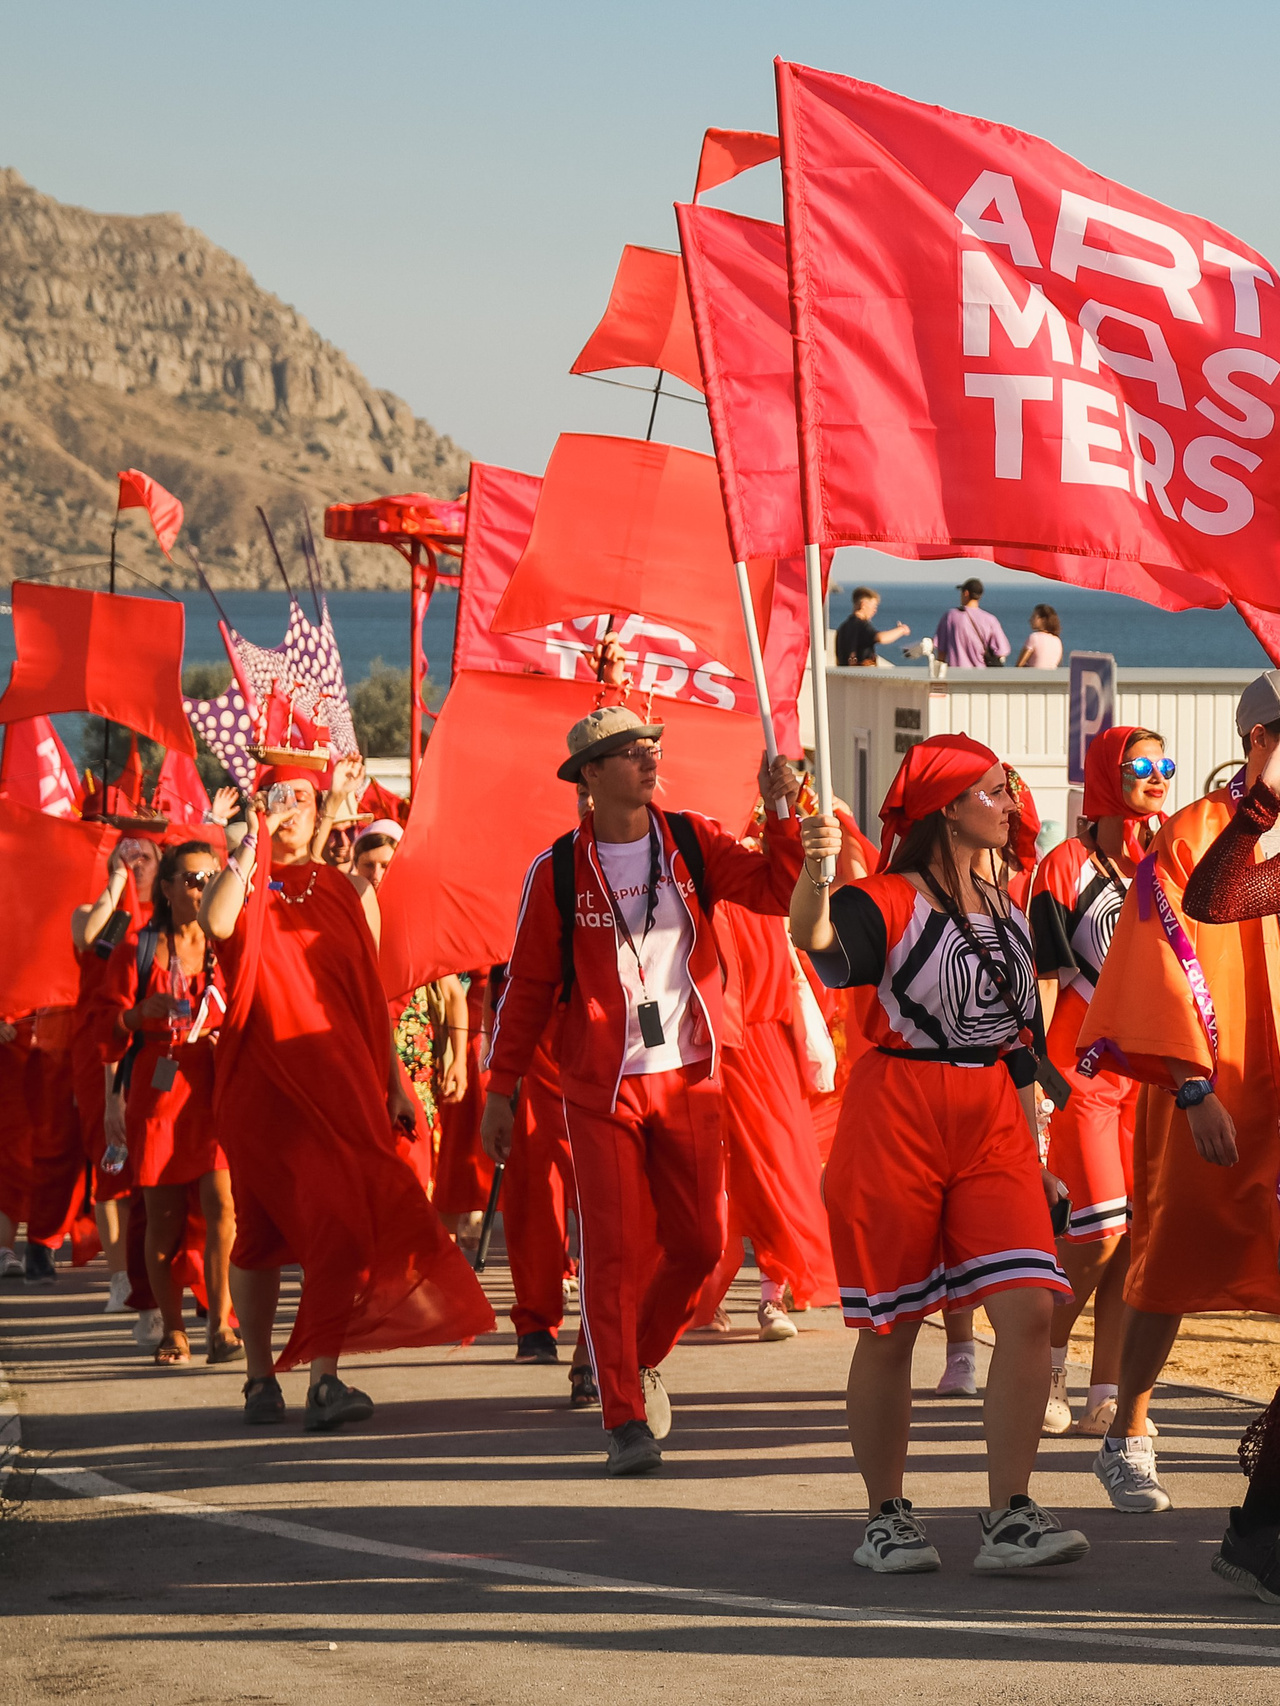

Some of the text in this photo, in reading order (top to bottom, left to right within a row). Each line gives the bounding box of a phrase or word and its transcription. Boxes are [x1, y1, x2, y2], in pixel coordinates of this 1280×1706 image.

[954, 169, 1274, 338] ART
[964, 373, 1263, 536] TERS
[1080, 671, 1103, 770] P
[577, 890, 594, 908] rt
[1106, 1466, 1125, 1489] N
